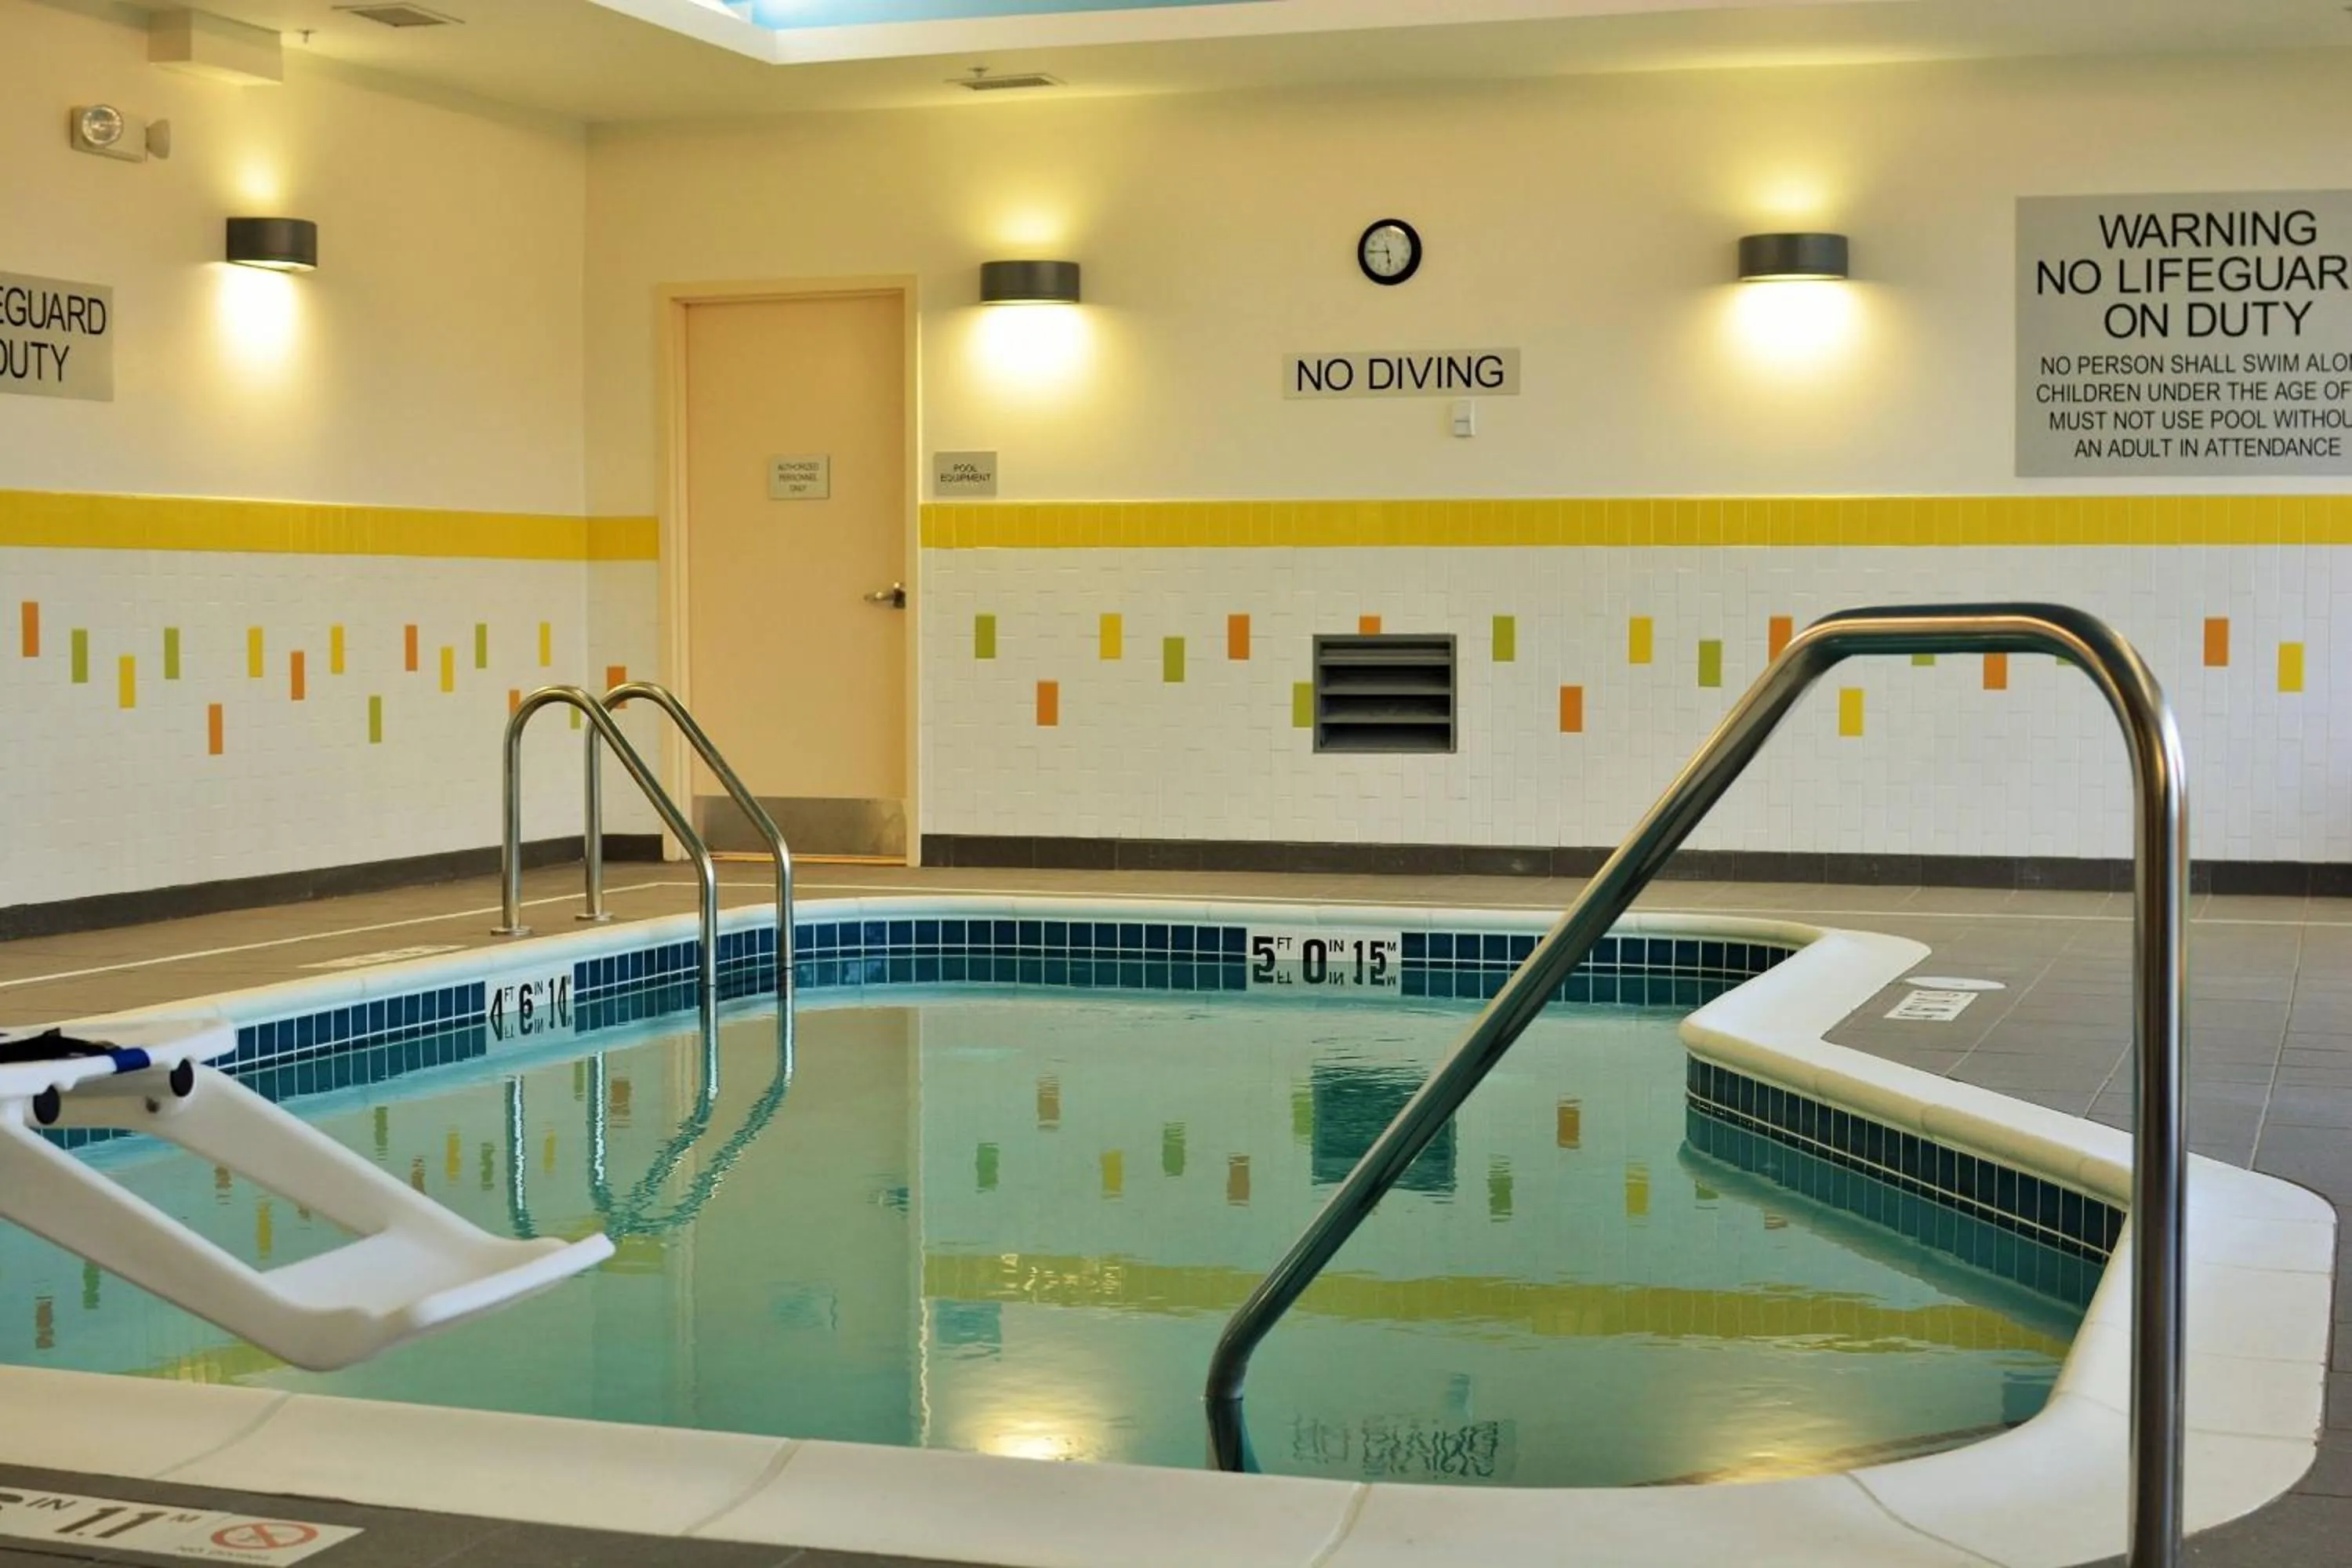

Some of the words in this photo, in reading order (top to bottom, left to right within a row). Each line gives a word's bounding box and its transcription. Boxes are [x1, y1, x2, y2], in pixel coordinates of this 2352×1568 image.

[2098, 210, 2318, 249] WARNING
[2037, 259, 2102, 295] NO
[2118, 255, 2352, 293] LIFEGUAR
[2104, 303, 2169, 339] ON
[2187, 300, 2314, 338] DUTY
[1297, 358, 1354, 391] NO
[1368, 355, 1504, 390] DIVING
[2041, 355, 2071, 376] NO
[2078, 354, 2164, 375] PERSON
[2170, 354, 2236, 374] SHALL
[2243, 353, 2299, 373] SWIM
[2305, 352, 2352, 372] ALO
[2036, 383, 2142, 403] CHILDREN
[2147, 382, 2220, 402] UNDER
[2227, 382, 2268, 401] THE
[2274, 381, 2317, 401] AGE
[2324, 381, 2352, 400] OF
[2049, 411, 2107, 431] MUST
[2114, 411, 2155, 430] NOT
[2161, 410, 2204, 430] USE
[2210, 409, 2267, 429] POOL
[2074, 439, 2102, 458] AN
[2107, 438, 2172, 458] ADULT
[2180, 438, 2199, 457] IN
[2205, 437, 2342, 457] ATTENDANCE
[940, 473, 991, 482] EQUIPMENT
[953, 463, 977, 472] POOL
[1277, 937, 1293, 950] FT
[1329, 939, 1345, 952] IN
[1387, 942, 1396, 951] M
[504, 986, 515, 1001] FT
[534, 980, 544, 996] IN
[25, 1497, 78, 1510] IN
